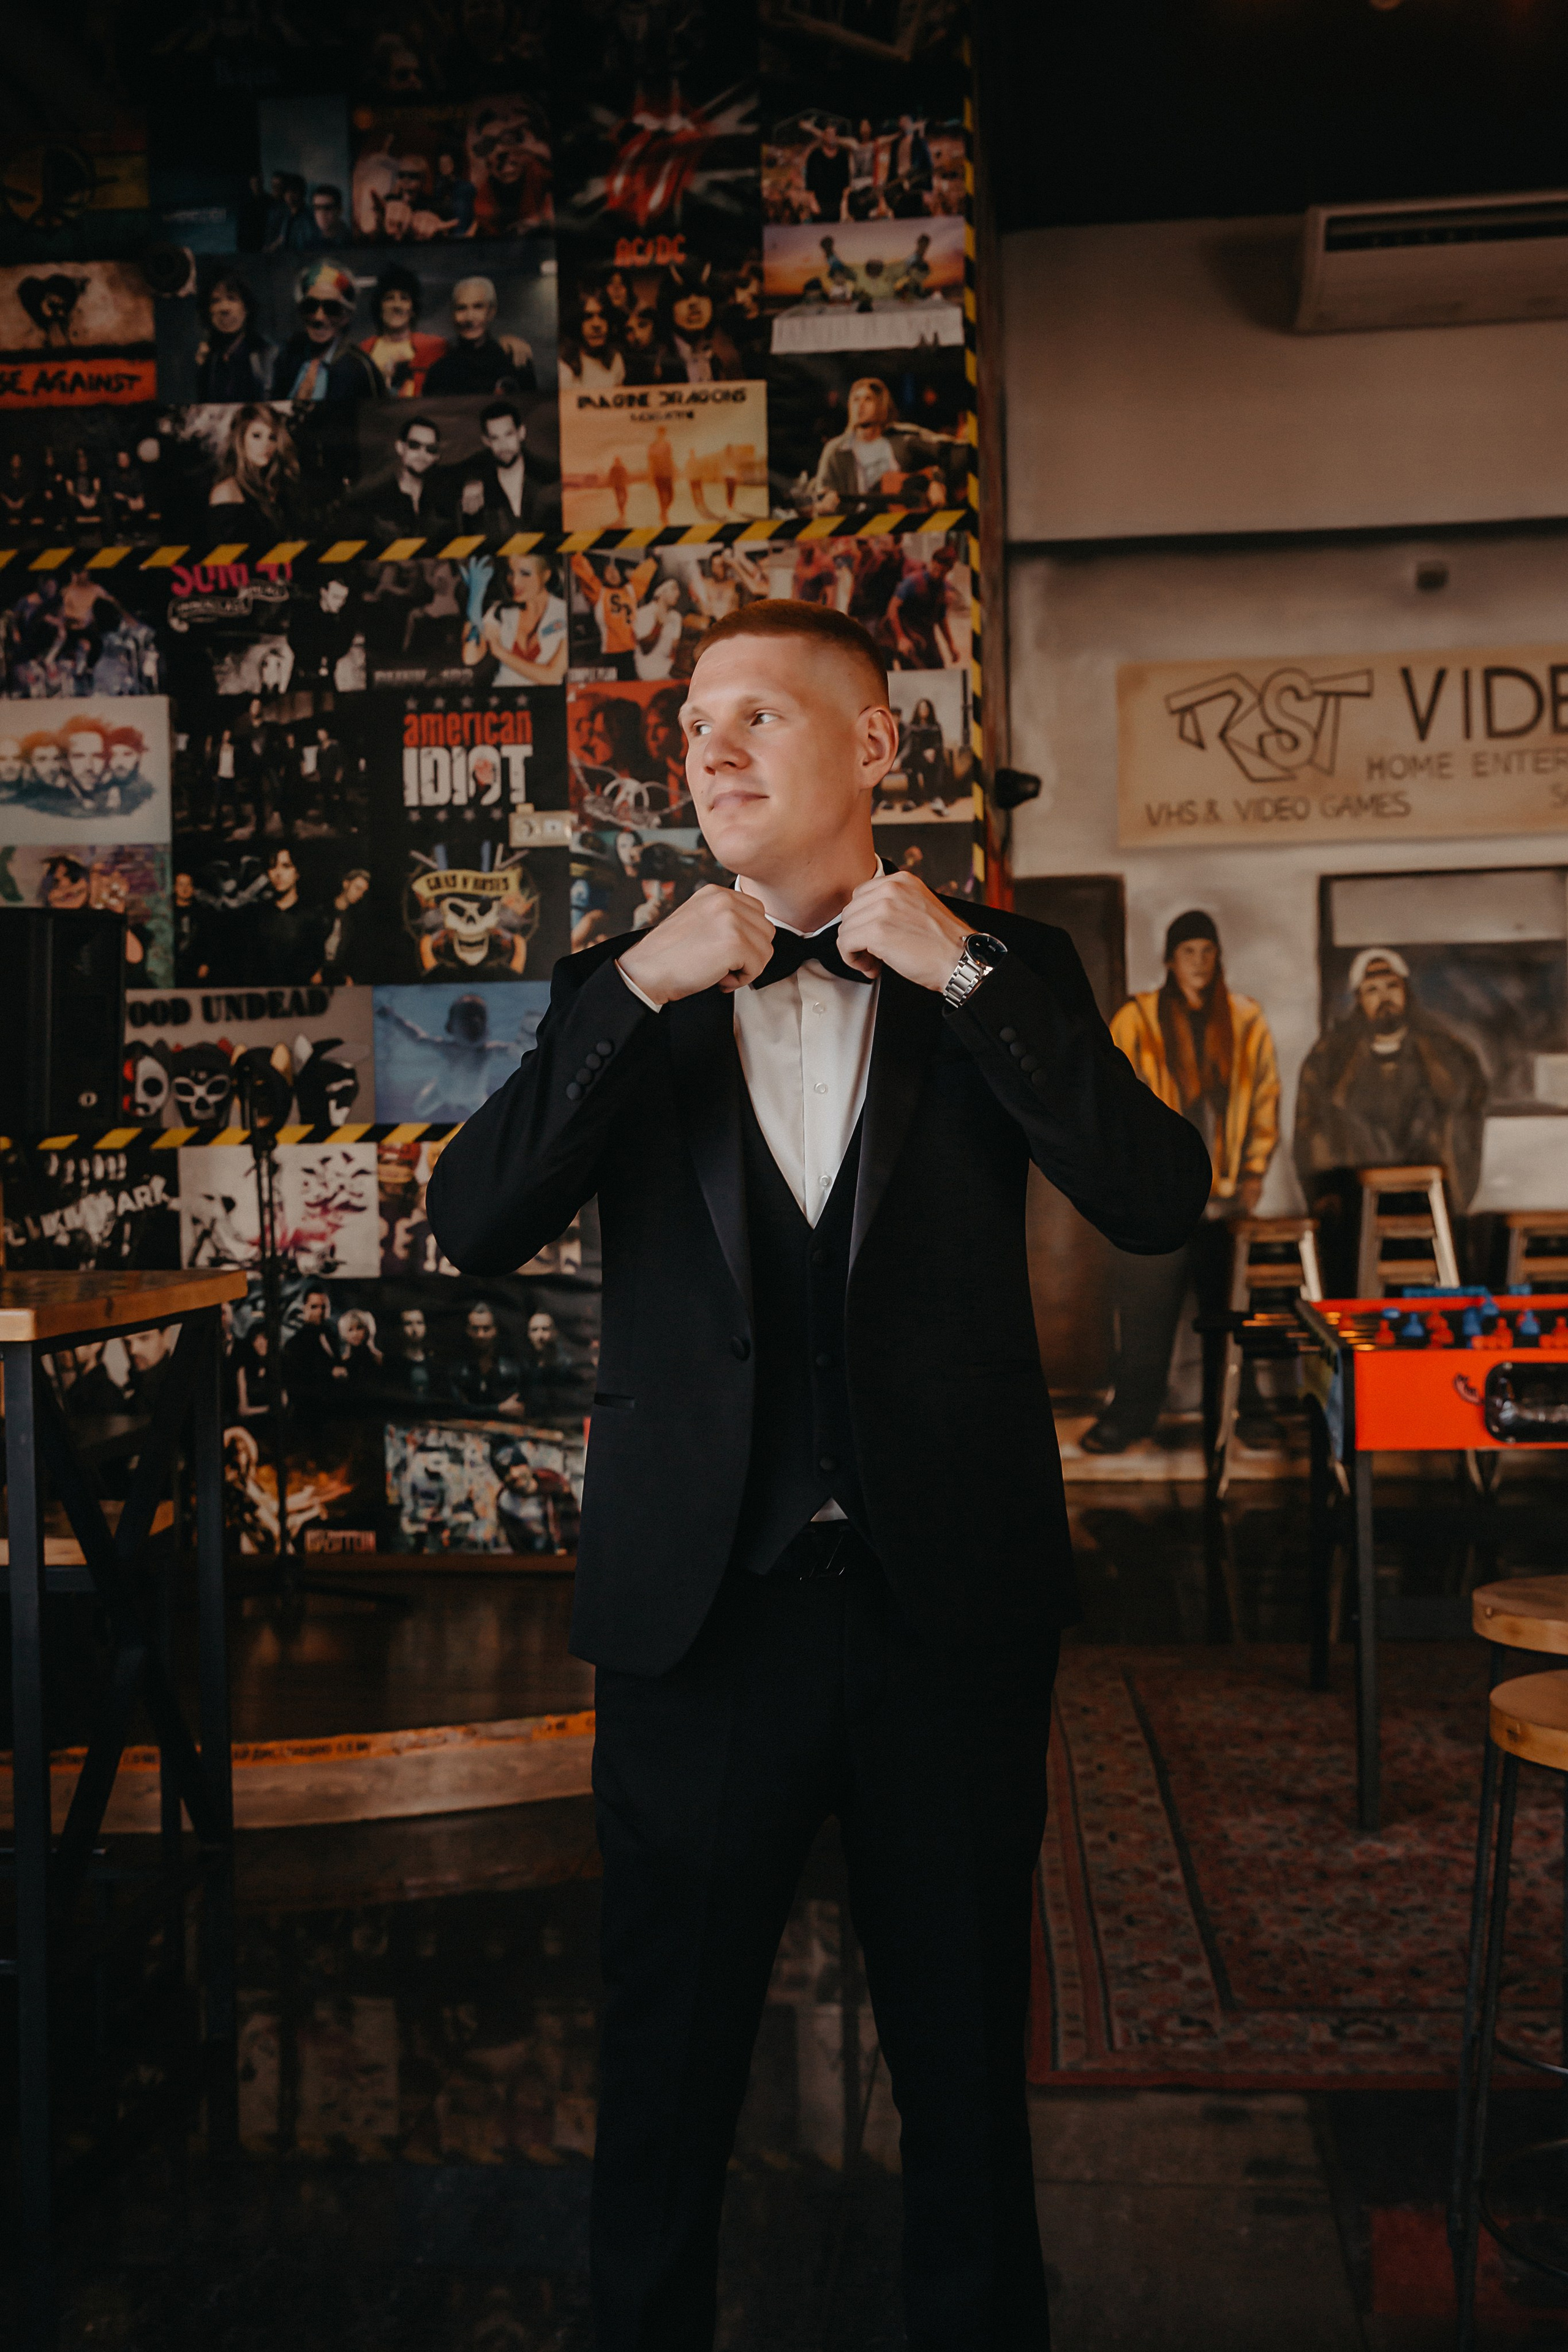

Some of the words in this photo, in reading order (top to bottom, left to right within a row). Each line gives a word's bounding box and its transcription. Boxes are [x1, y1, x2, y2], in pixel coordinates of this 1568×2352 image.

[613, 233, 687, 268] AC/DC
[32, 370, 142, 394] AGAINST
[402, 710, 533, 747] american
[402, 744, 534, 807] IDIOT
[1366, 752, 1454, 781] HOME
[1145, 799, 1197, 826] VHS
[1232, 796, 1311, 822] VIDEO
[1320, 791, 1411, 820] GAMES
[201, 989, 328, 1023] UNDEAD
